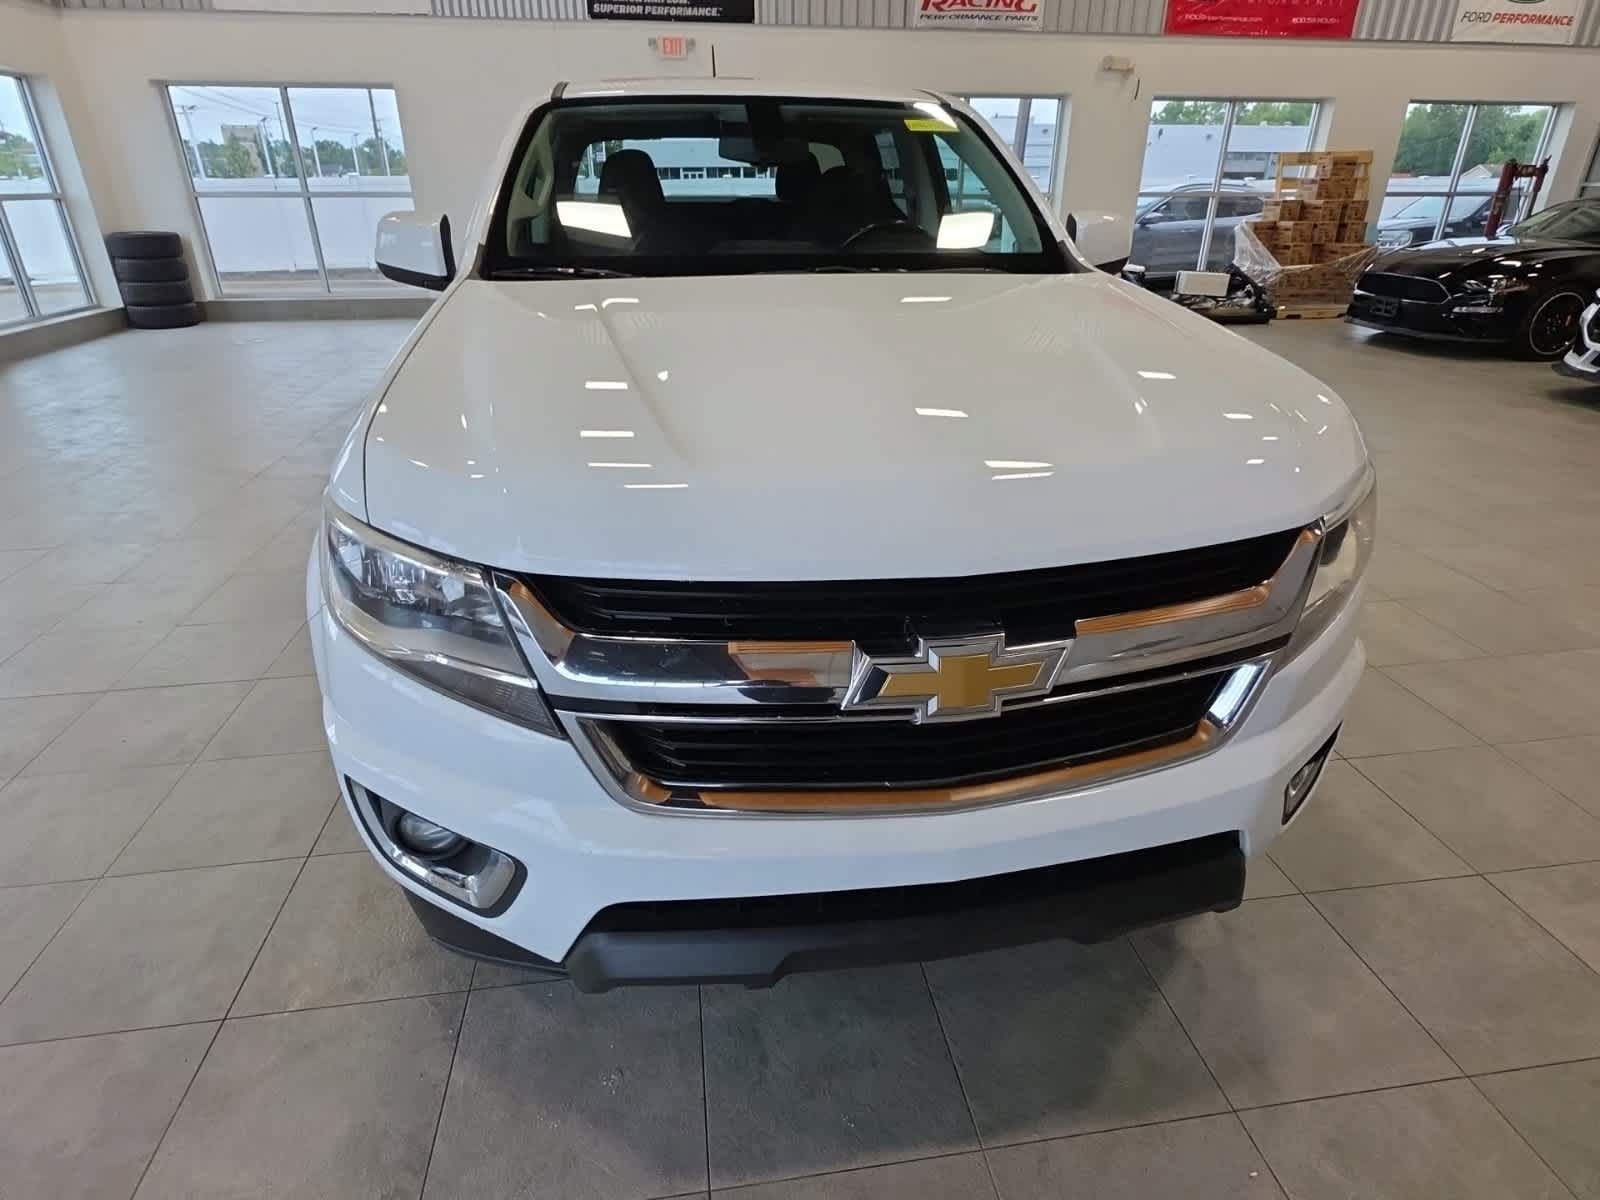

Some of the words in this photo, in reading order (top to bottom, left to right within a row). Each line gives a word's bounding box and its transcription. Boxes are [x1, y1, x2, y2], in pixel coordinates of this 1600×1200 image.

[593, 3, 643, 14] SUPERIOR
[1461, 11, 1492, 23] FORD
[1492, 12, 1575, 26] PERFORMANCE
[662, 38, 682, 57] EXIT
